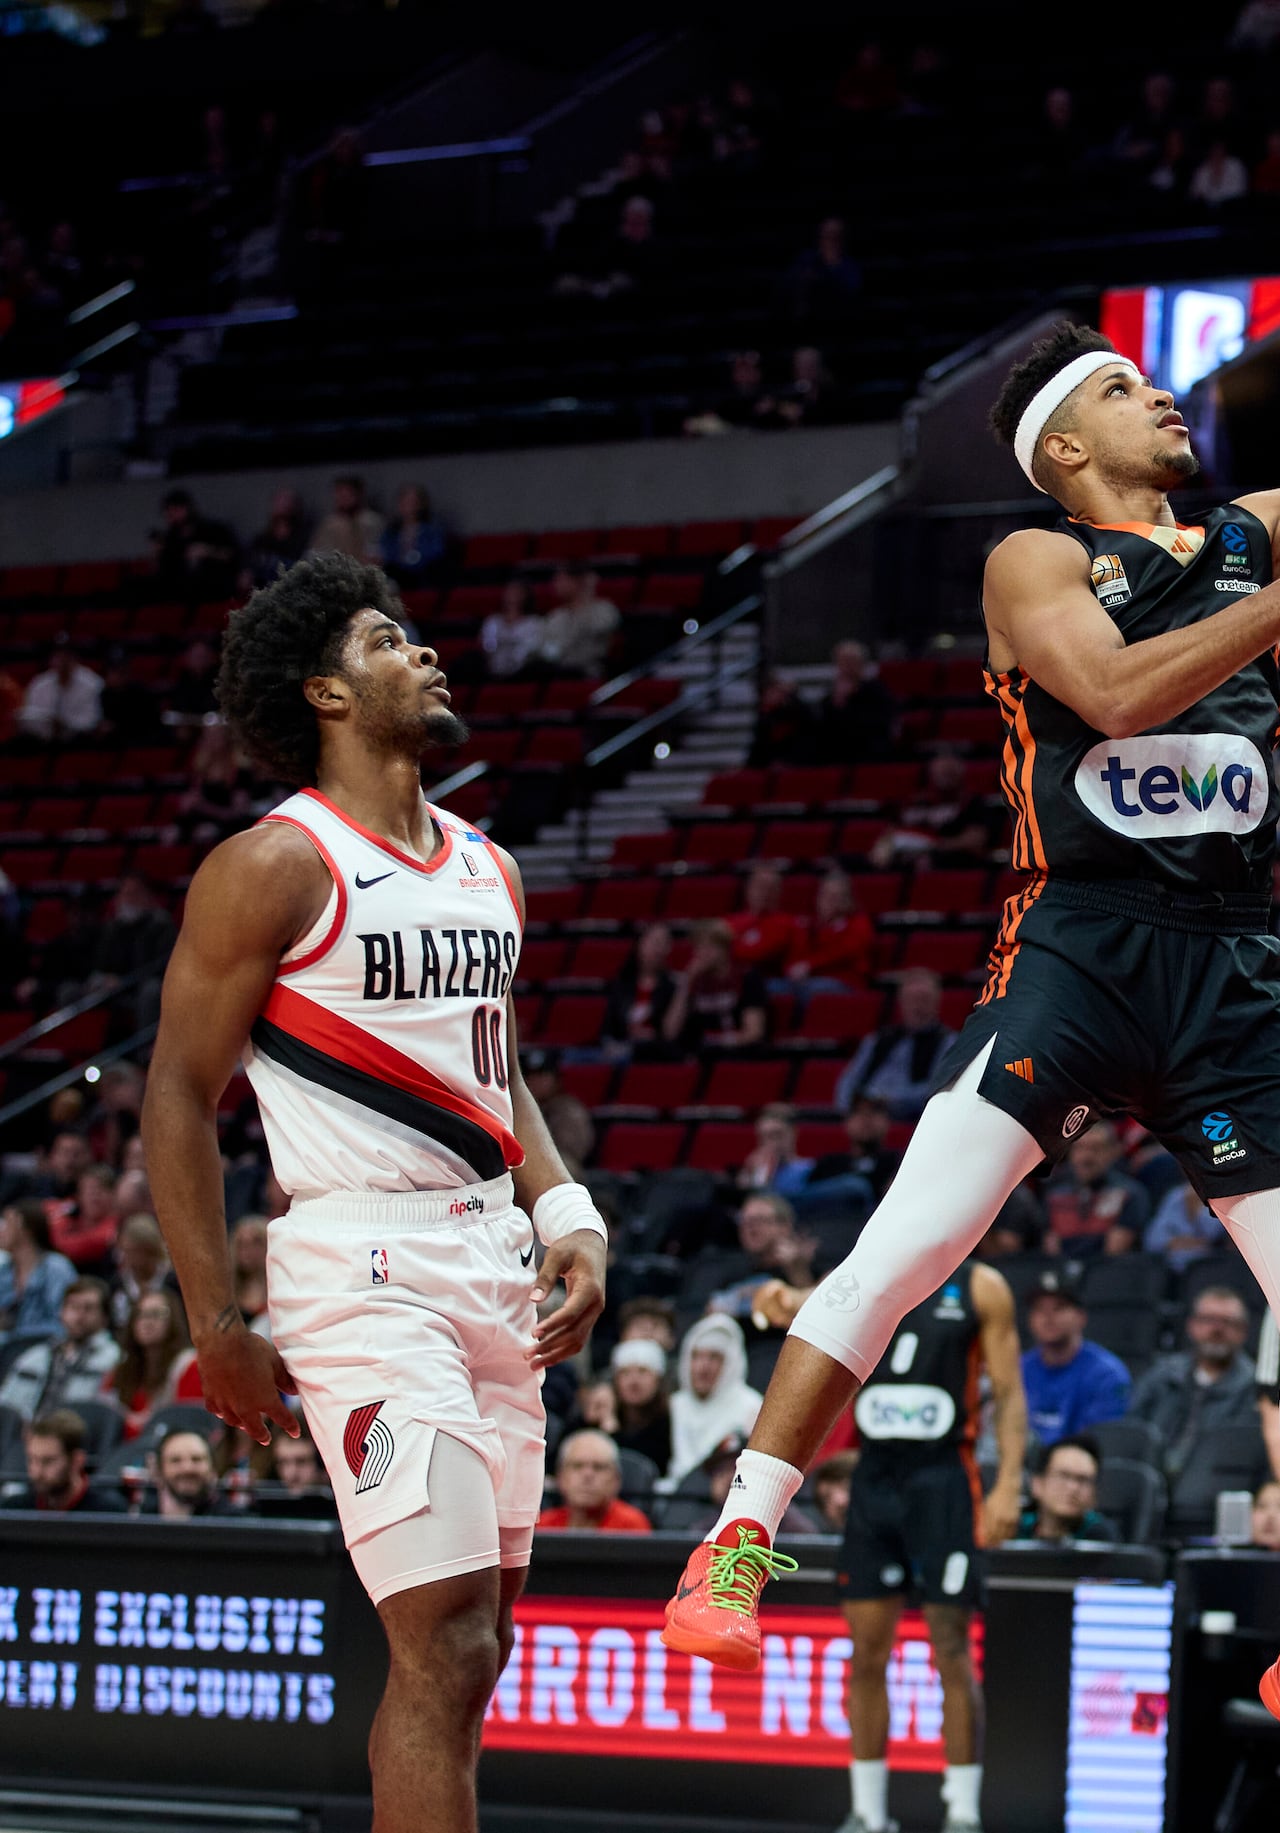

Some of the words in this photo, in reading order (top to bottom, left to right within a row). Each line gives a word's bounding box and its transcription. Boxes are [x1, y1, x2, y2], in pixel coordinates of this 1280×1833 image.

[1105, 594, 1124, 605] ulm
[1222, 565, 1251, 576] EuroCup
[1101, 756, 1252, 817] teva
[356, 929, 516, 1000] BLAZERS
[471, 1004, 507, 1091] 00
[1213, 1148, 1247, 1165] EuroCup
[450, 1195, 484, 1216] ripcity
[30, 1587, 81, 1645] IN
[94, 1590, 326, 1656] EXCLUSIVE
[0, 1659, 79, 1711] ENT
[93, 1662, 335, 1725] DISCOUNTS
